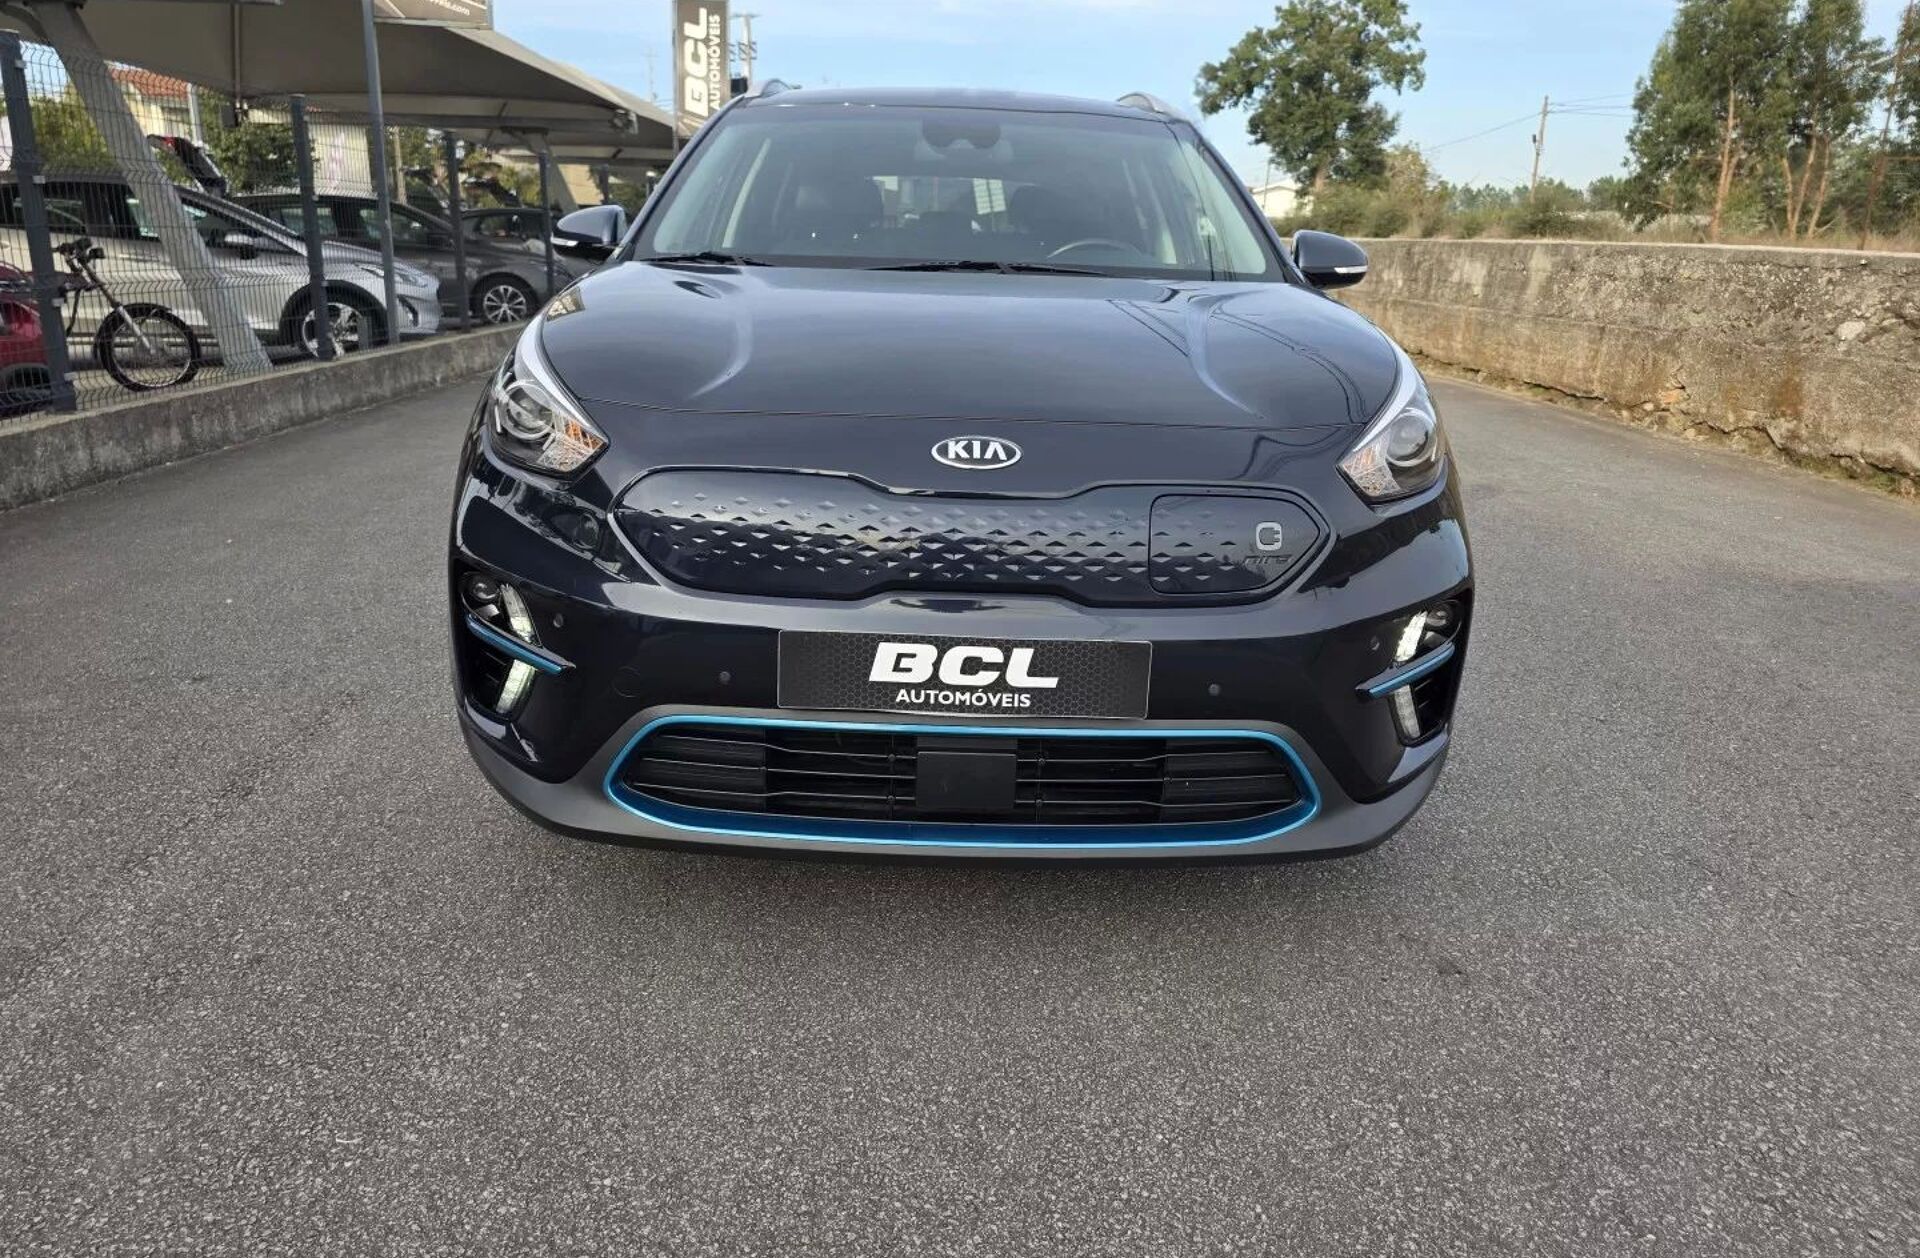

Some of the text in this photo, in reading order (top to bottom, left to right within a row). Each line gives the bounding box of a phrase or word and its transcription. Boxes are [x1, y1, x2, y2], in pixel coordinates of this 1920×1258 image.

[684, 7, 708, 117] BCL
[708, 14, 721, 111] AUTOMÓVEIS
[947, 440, 1007, 461] KIA
[868, 641, 1060, 689] BCL
[895, 688, 1032, 708] AUTOMÓVEIS
